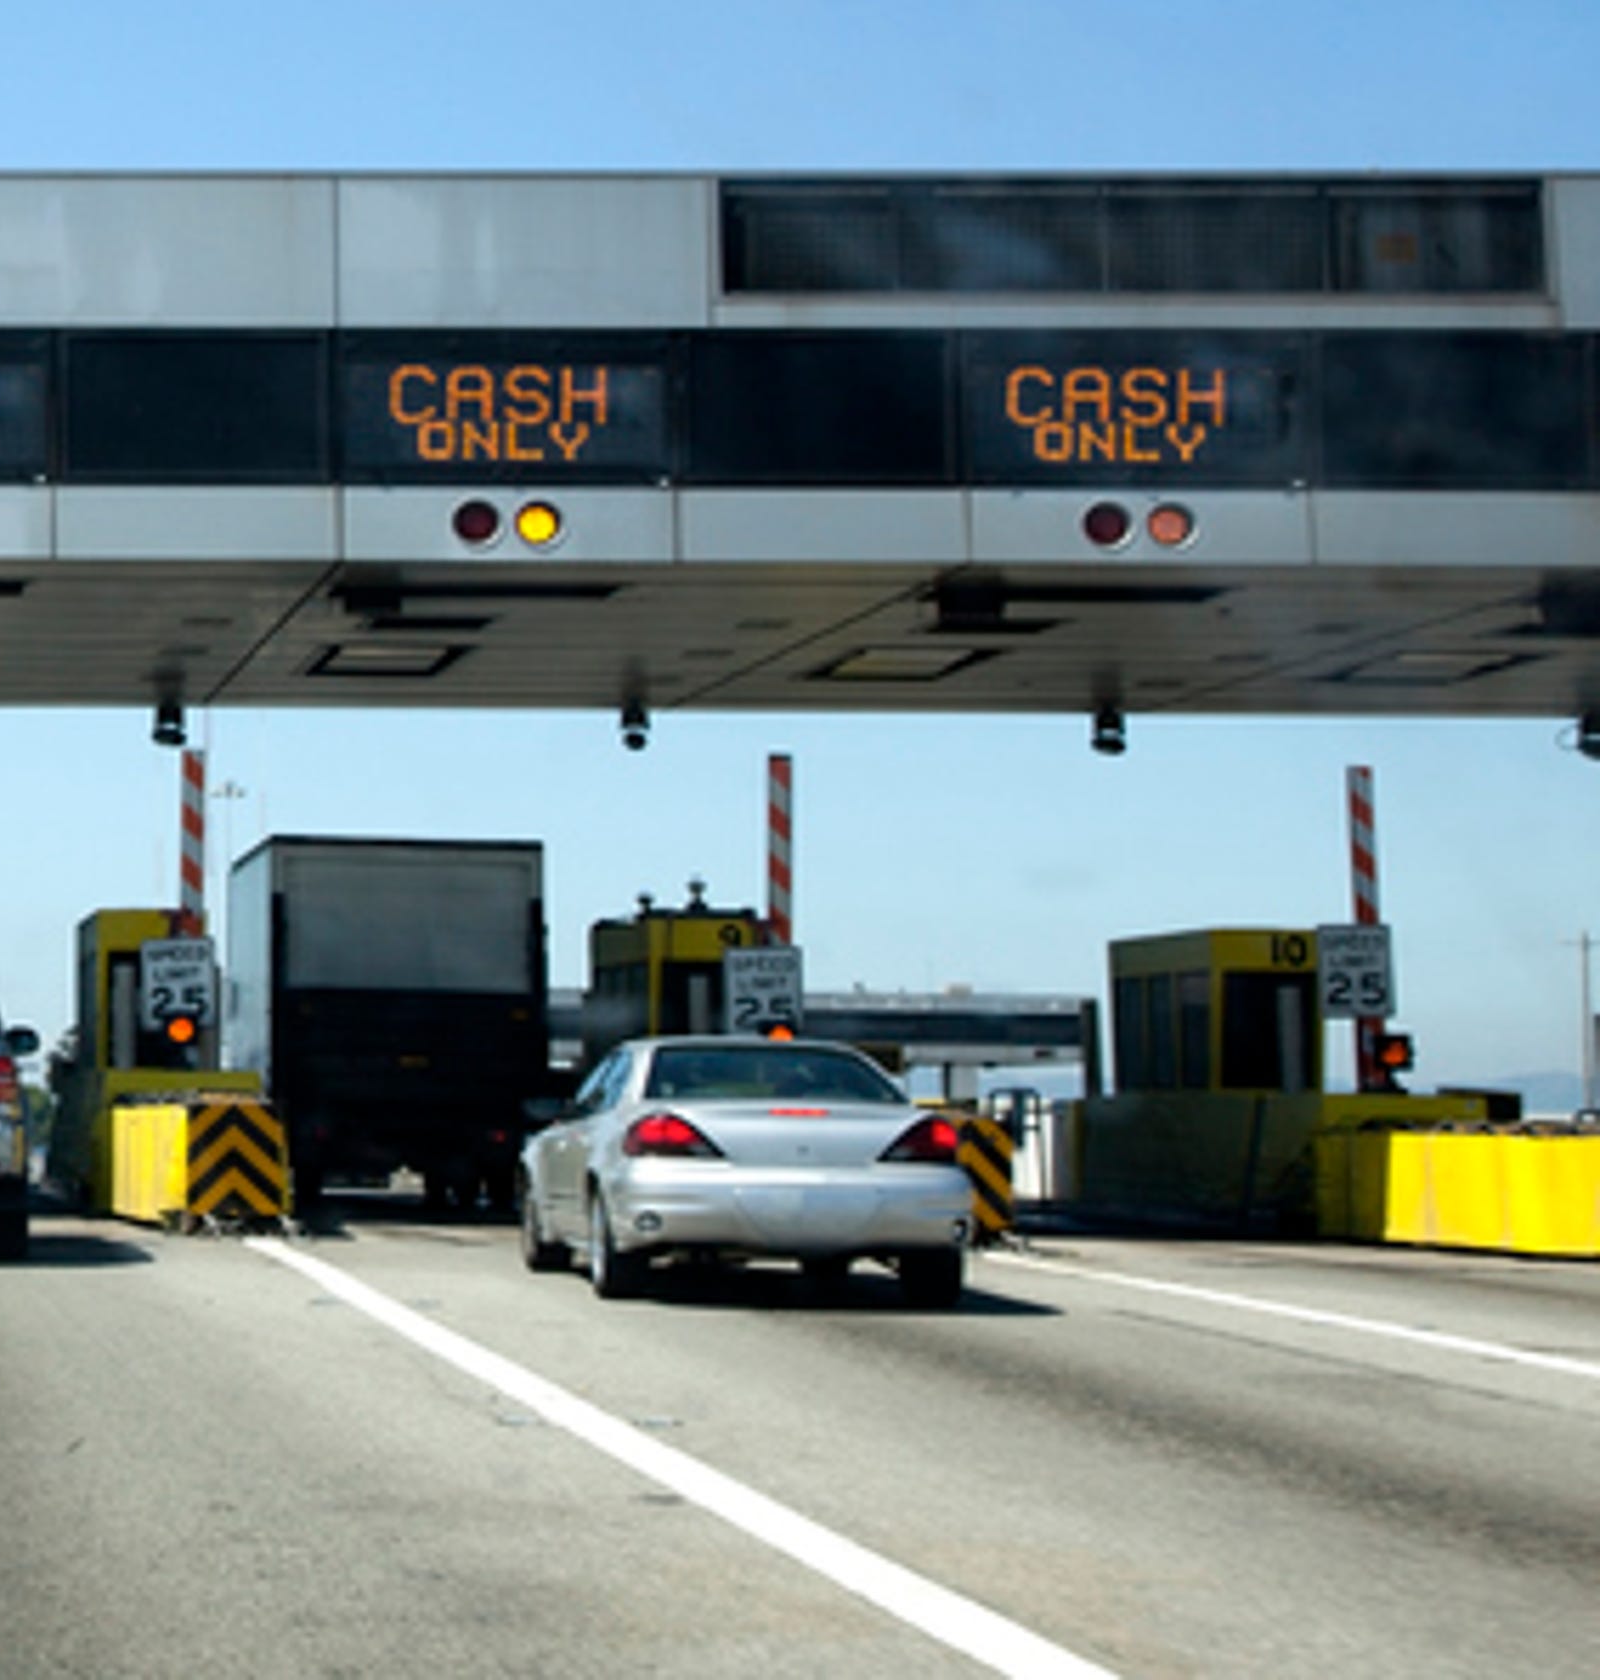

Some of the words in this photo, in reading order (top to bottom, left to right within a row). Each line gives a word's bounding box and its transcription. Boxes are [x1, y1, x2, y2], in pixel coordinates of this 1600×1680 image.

[390, 365, 606, 425] CASH
[1006, 366, 1223, 427] CASH
[417, 419, 589, 461] ONLY
[1034, 421, 1205, 462] ONLY
[718, 923, 741, 946] 9
[1271, 933, 1307, 966] 10
[150, 985, 210, 1020] 25
[1327, 971, 1386, 1008] 25
[734, 996, 796, 1031] 25
